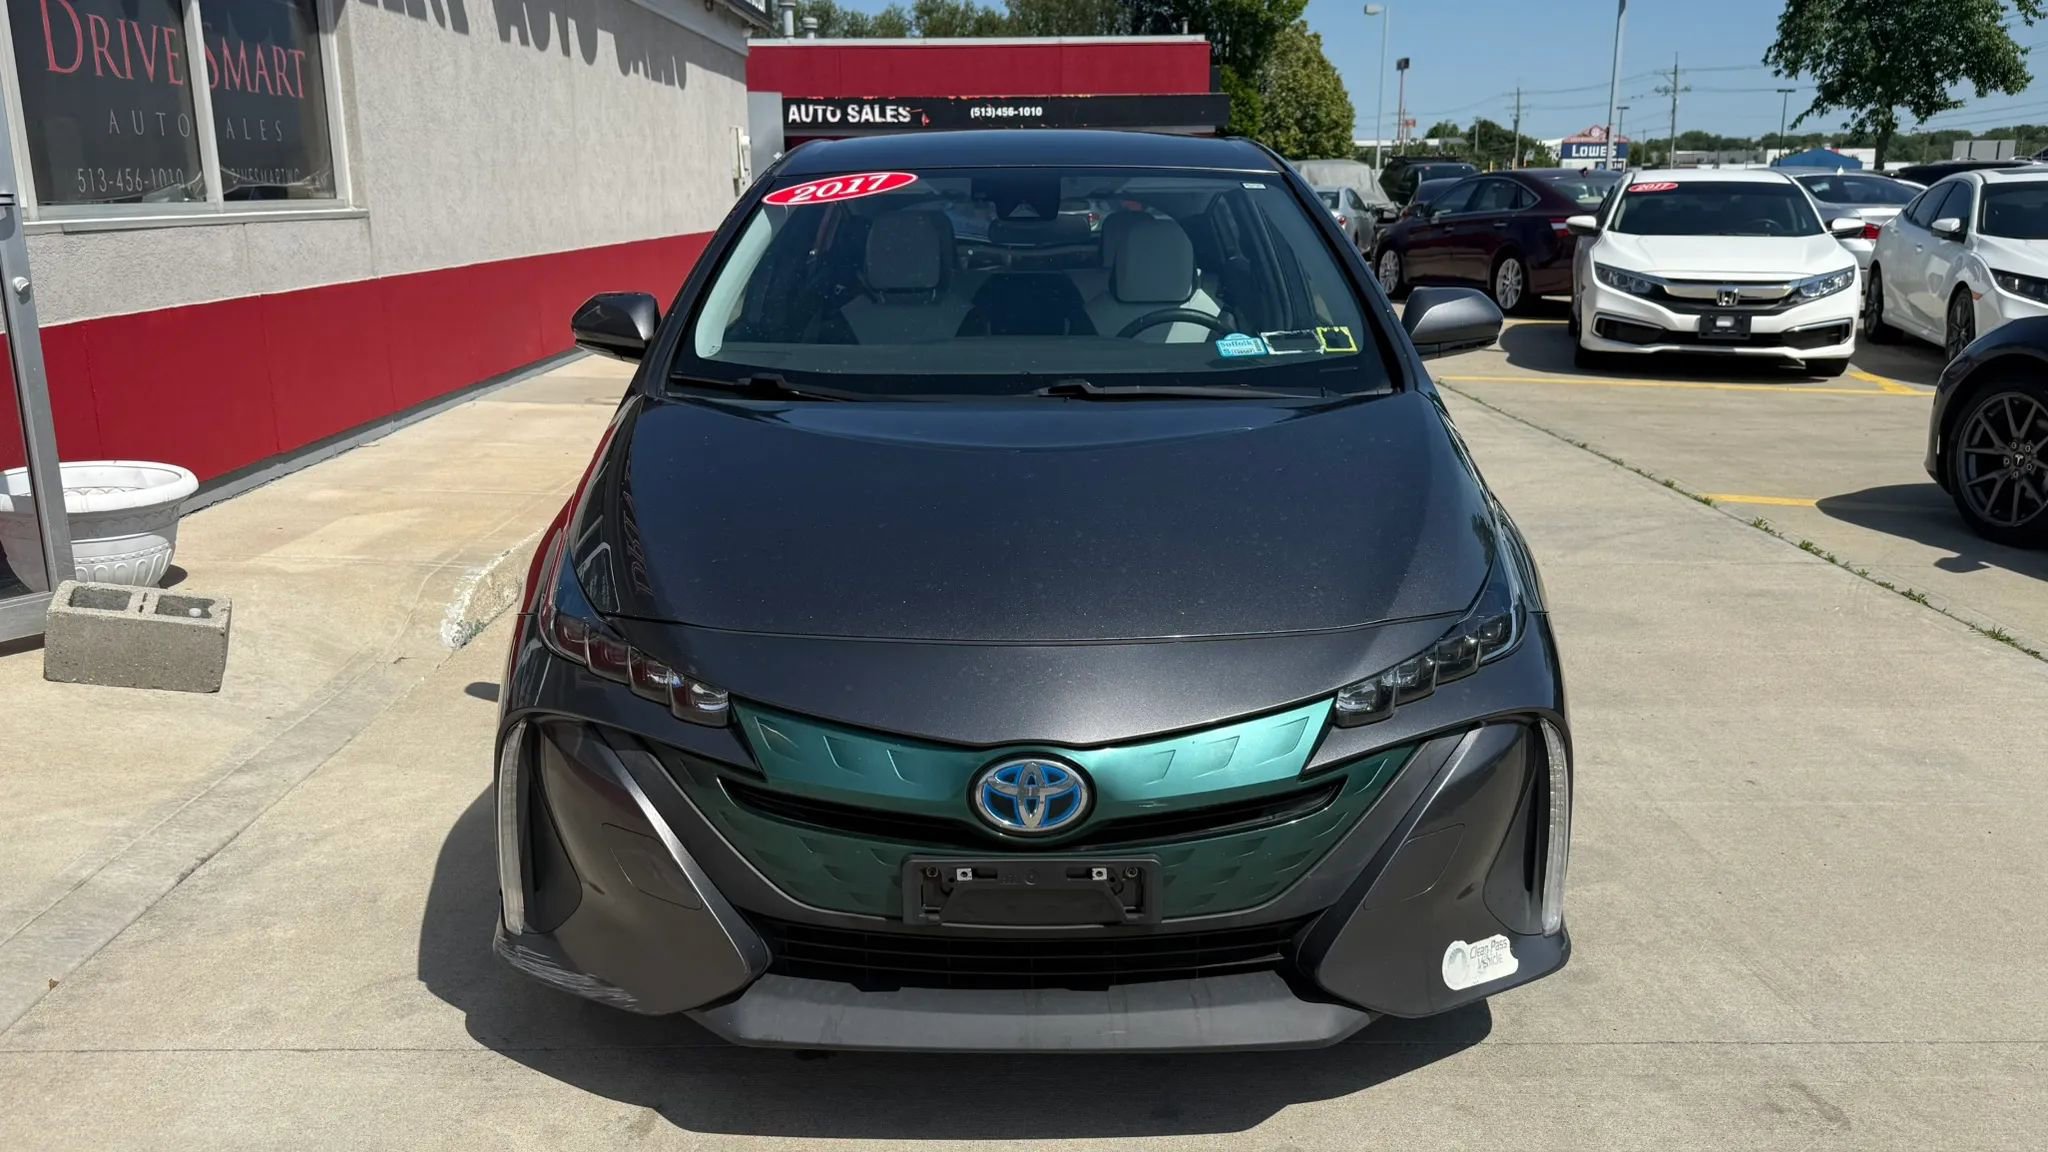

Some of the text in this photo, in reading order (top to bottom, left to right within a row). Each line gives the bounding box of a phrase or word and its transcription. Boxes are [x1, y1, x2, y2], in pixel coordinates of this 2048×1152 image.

[40, 0, 184, 86] DRIVE
[108, 108, 283, 142] AUTO ALES
[787, 103, 911, 123] AUTO SALES
[970, 106, 1043, 118] (513)456-1010
[787, 173, 891, 203] 2017
[1470, 938, 1508, 960] Clean Pass
